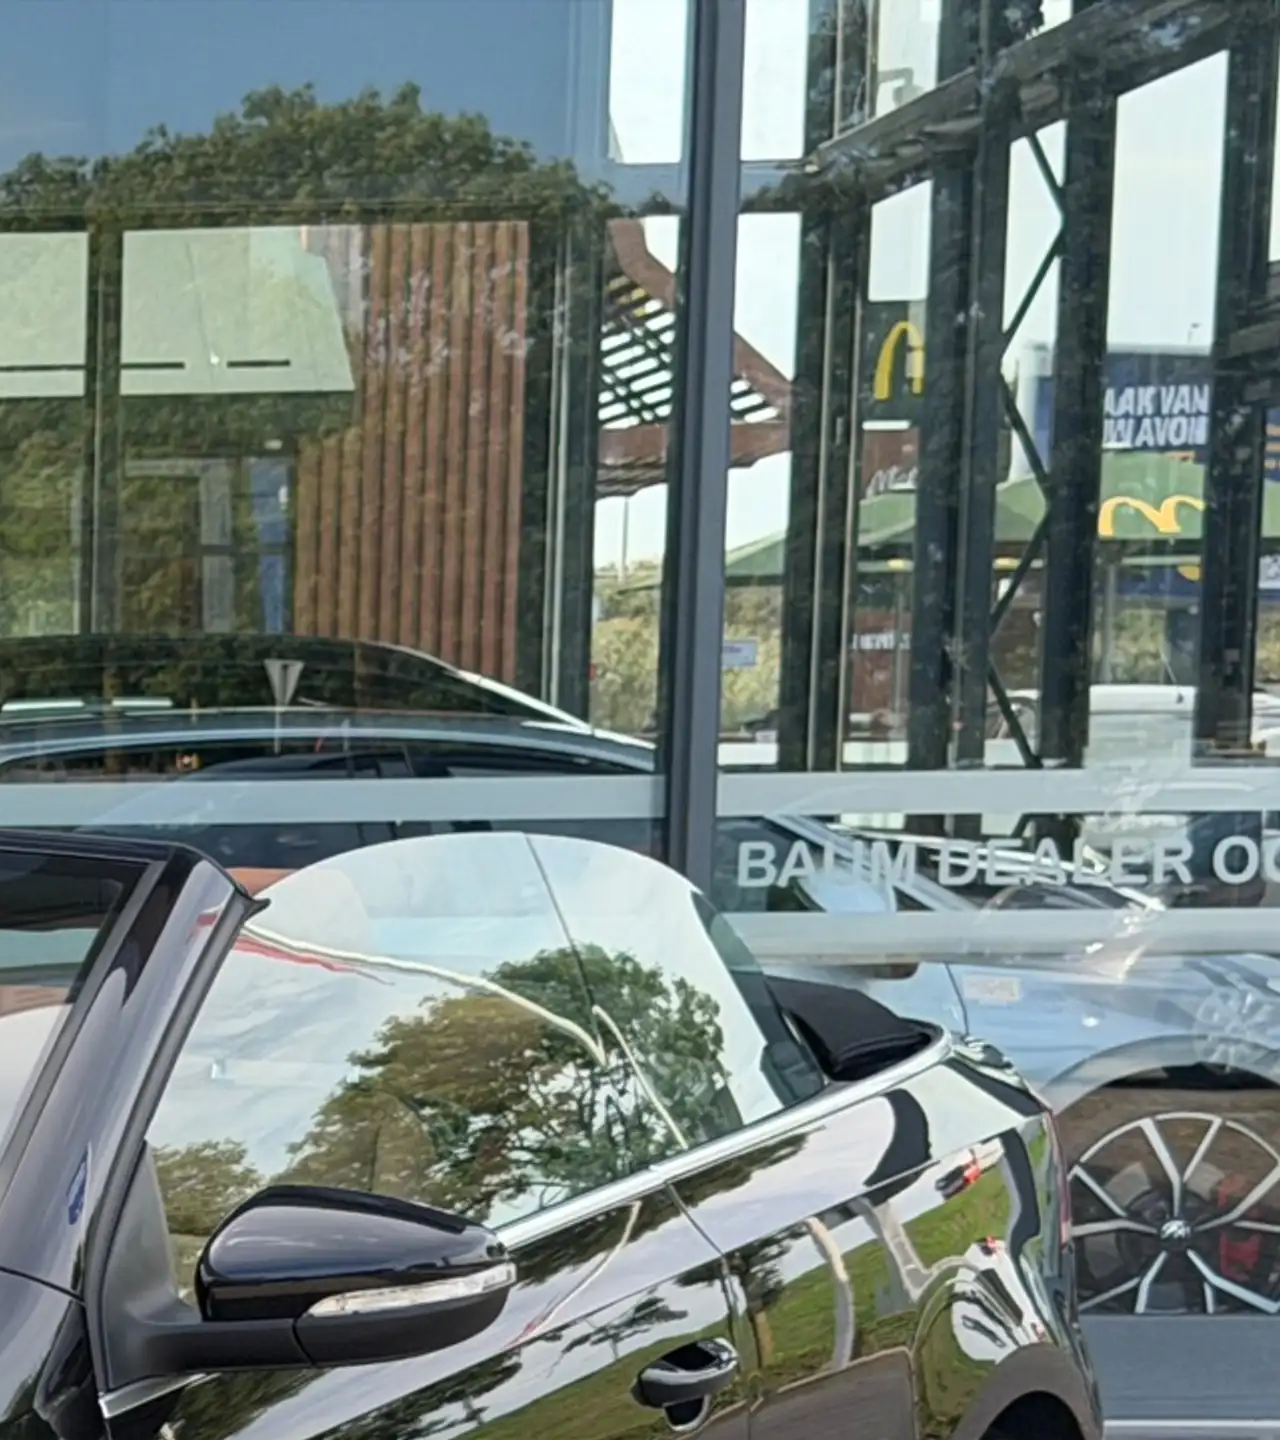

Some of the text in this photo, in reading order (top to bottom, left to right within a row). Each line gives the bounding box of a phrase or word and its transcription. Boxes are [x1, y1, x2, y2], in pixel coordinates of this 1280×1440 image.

[1160, 384, 1209, 415] VAN
[738, 839, 915, 888] BAUM
[939, 837, 1194, 886] DEALER
